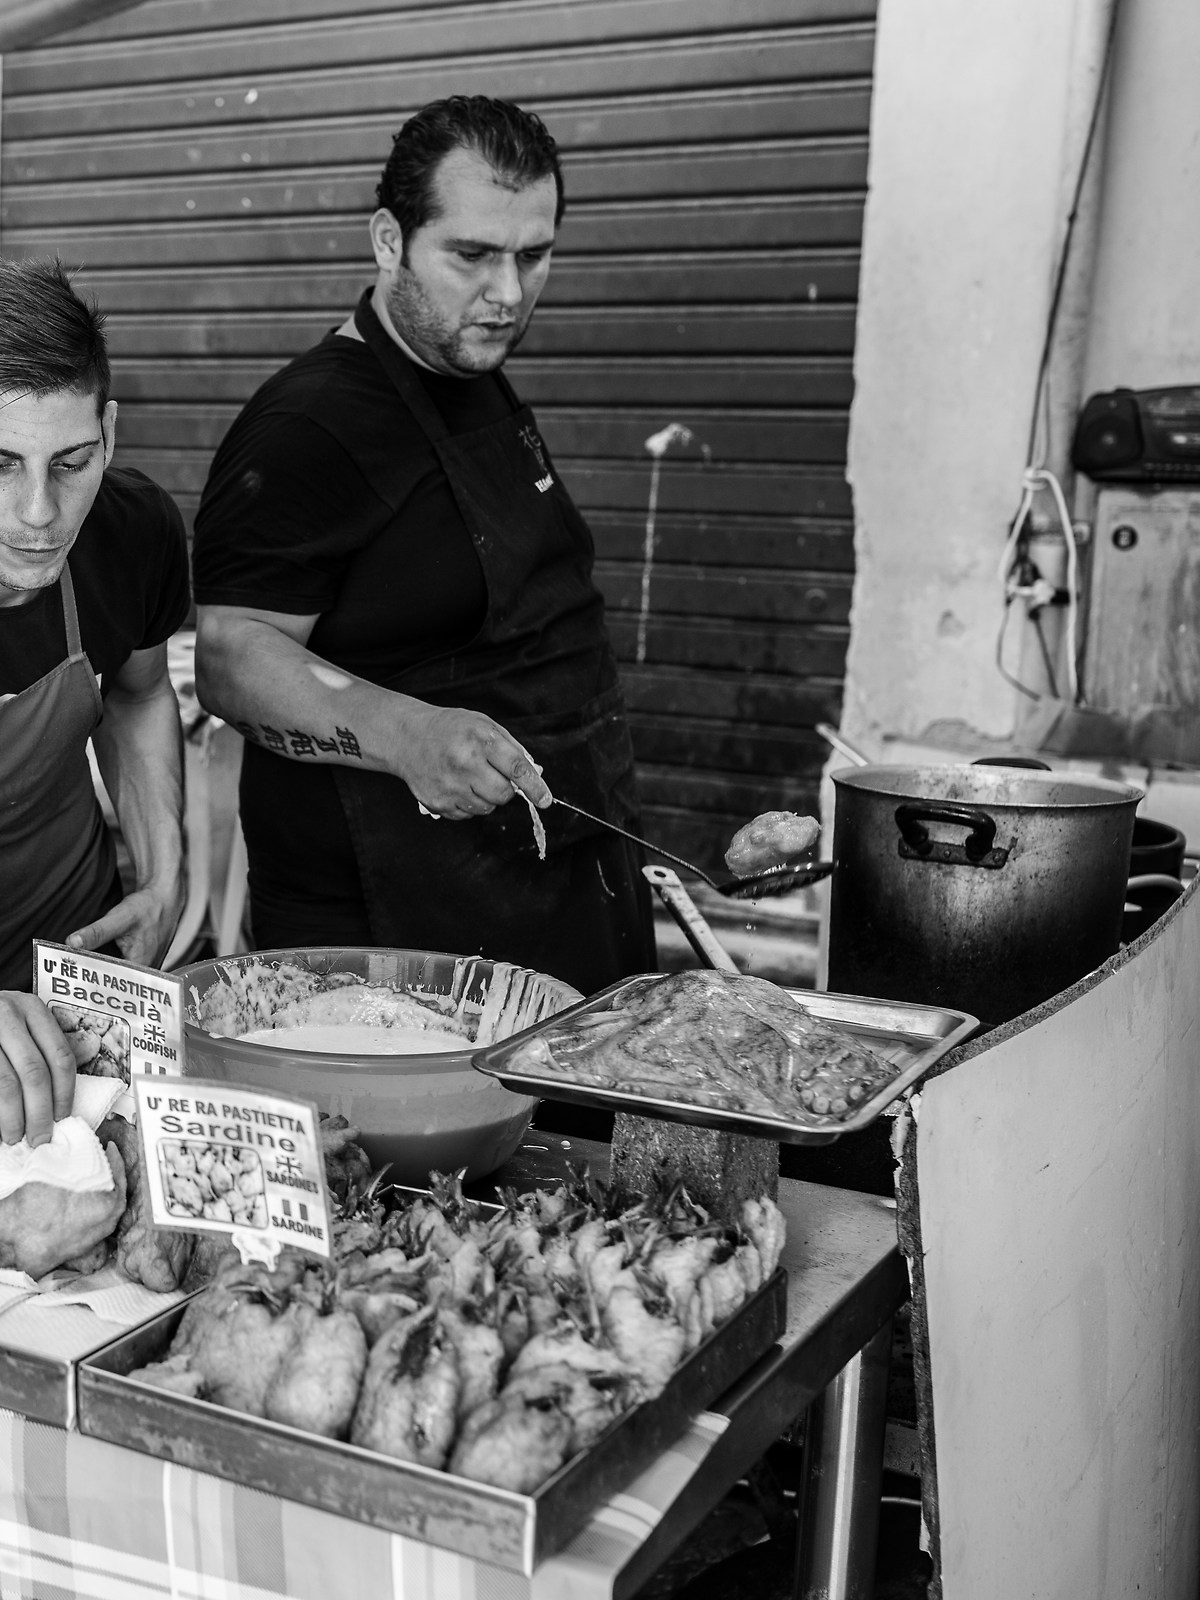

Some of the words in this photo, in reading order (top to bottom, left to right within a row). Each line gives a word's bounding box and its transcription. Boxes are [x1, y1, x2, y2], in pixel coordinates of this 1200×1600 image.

[44, 959, 57, 973] U'
[82, 968, 100, 985] RA
[103, 974, 172, 1007] PASTIETTA
[52, 976, 161, 1023] Baccalà
[133, 1037, 177, 1061] CODFISH
[147, 1096, 162, 1110] U'
[169, 1098, 190, 1113] RE
[195, 1101, 217, 1117] RA
[222, 1104, 306, 1135] PASTIETTA
[161, 1115, 295, 1152] Sardine
[266, 1170, 319, 1194] SARDINES
[272, 1216, 324, 1240] SARDINE
